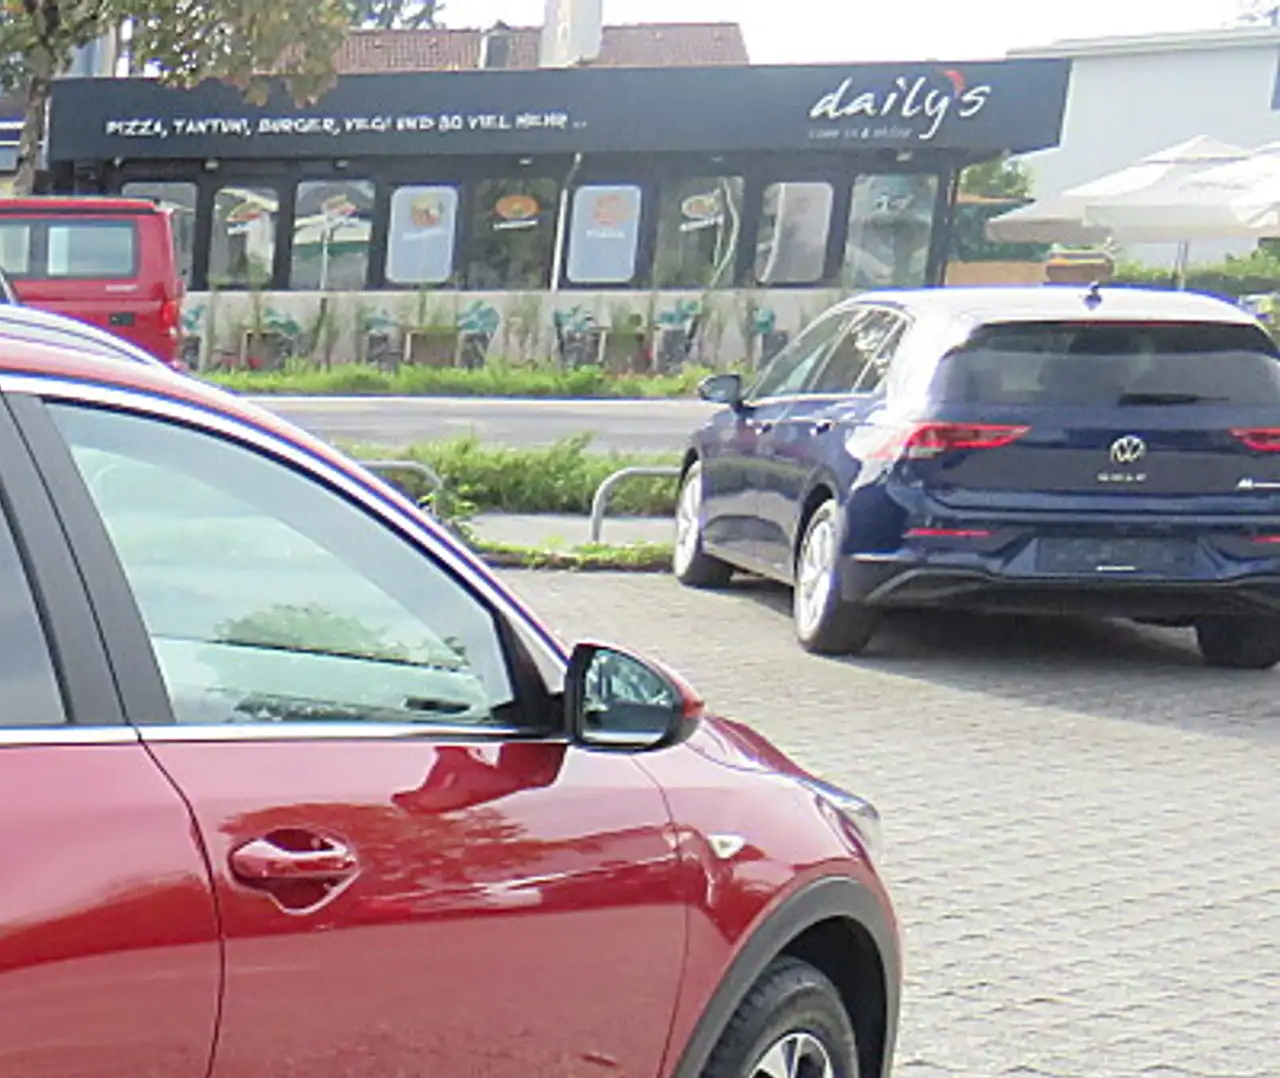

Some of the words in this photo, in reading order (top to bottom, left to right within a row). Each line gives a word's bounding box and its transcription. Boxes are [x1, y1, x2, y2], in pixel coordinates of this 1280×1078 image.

[105, 119, 168, 138] PIZZA,
[257, 117, 341, 136] BURGER,
[808, 70, 992, 140] daily's
